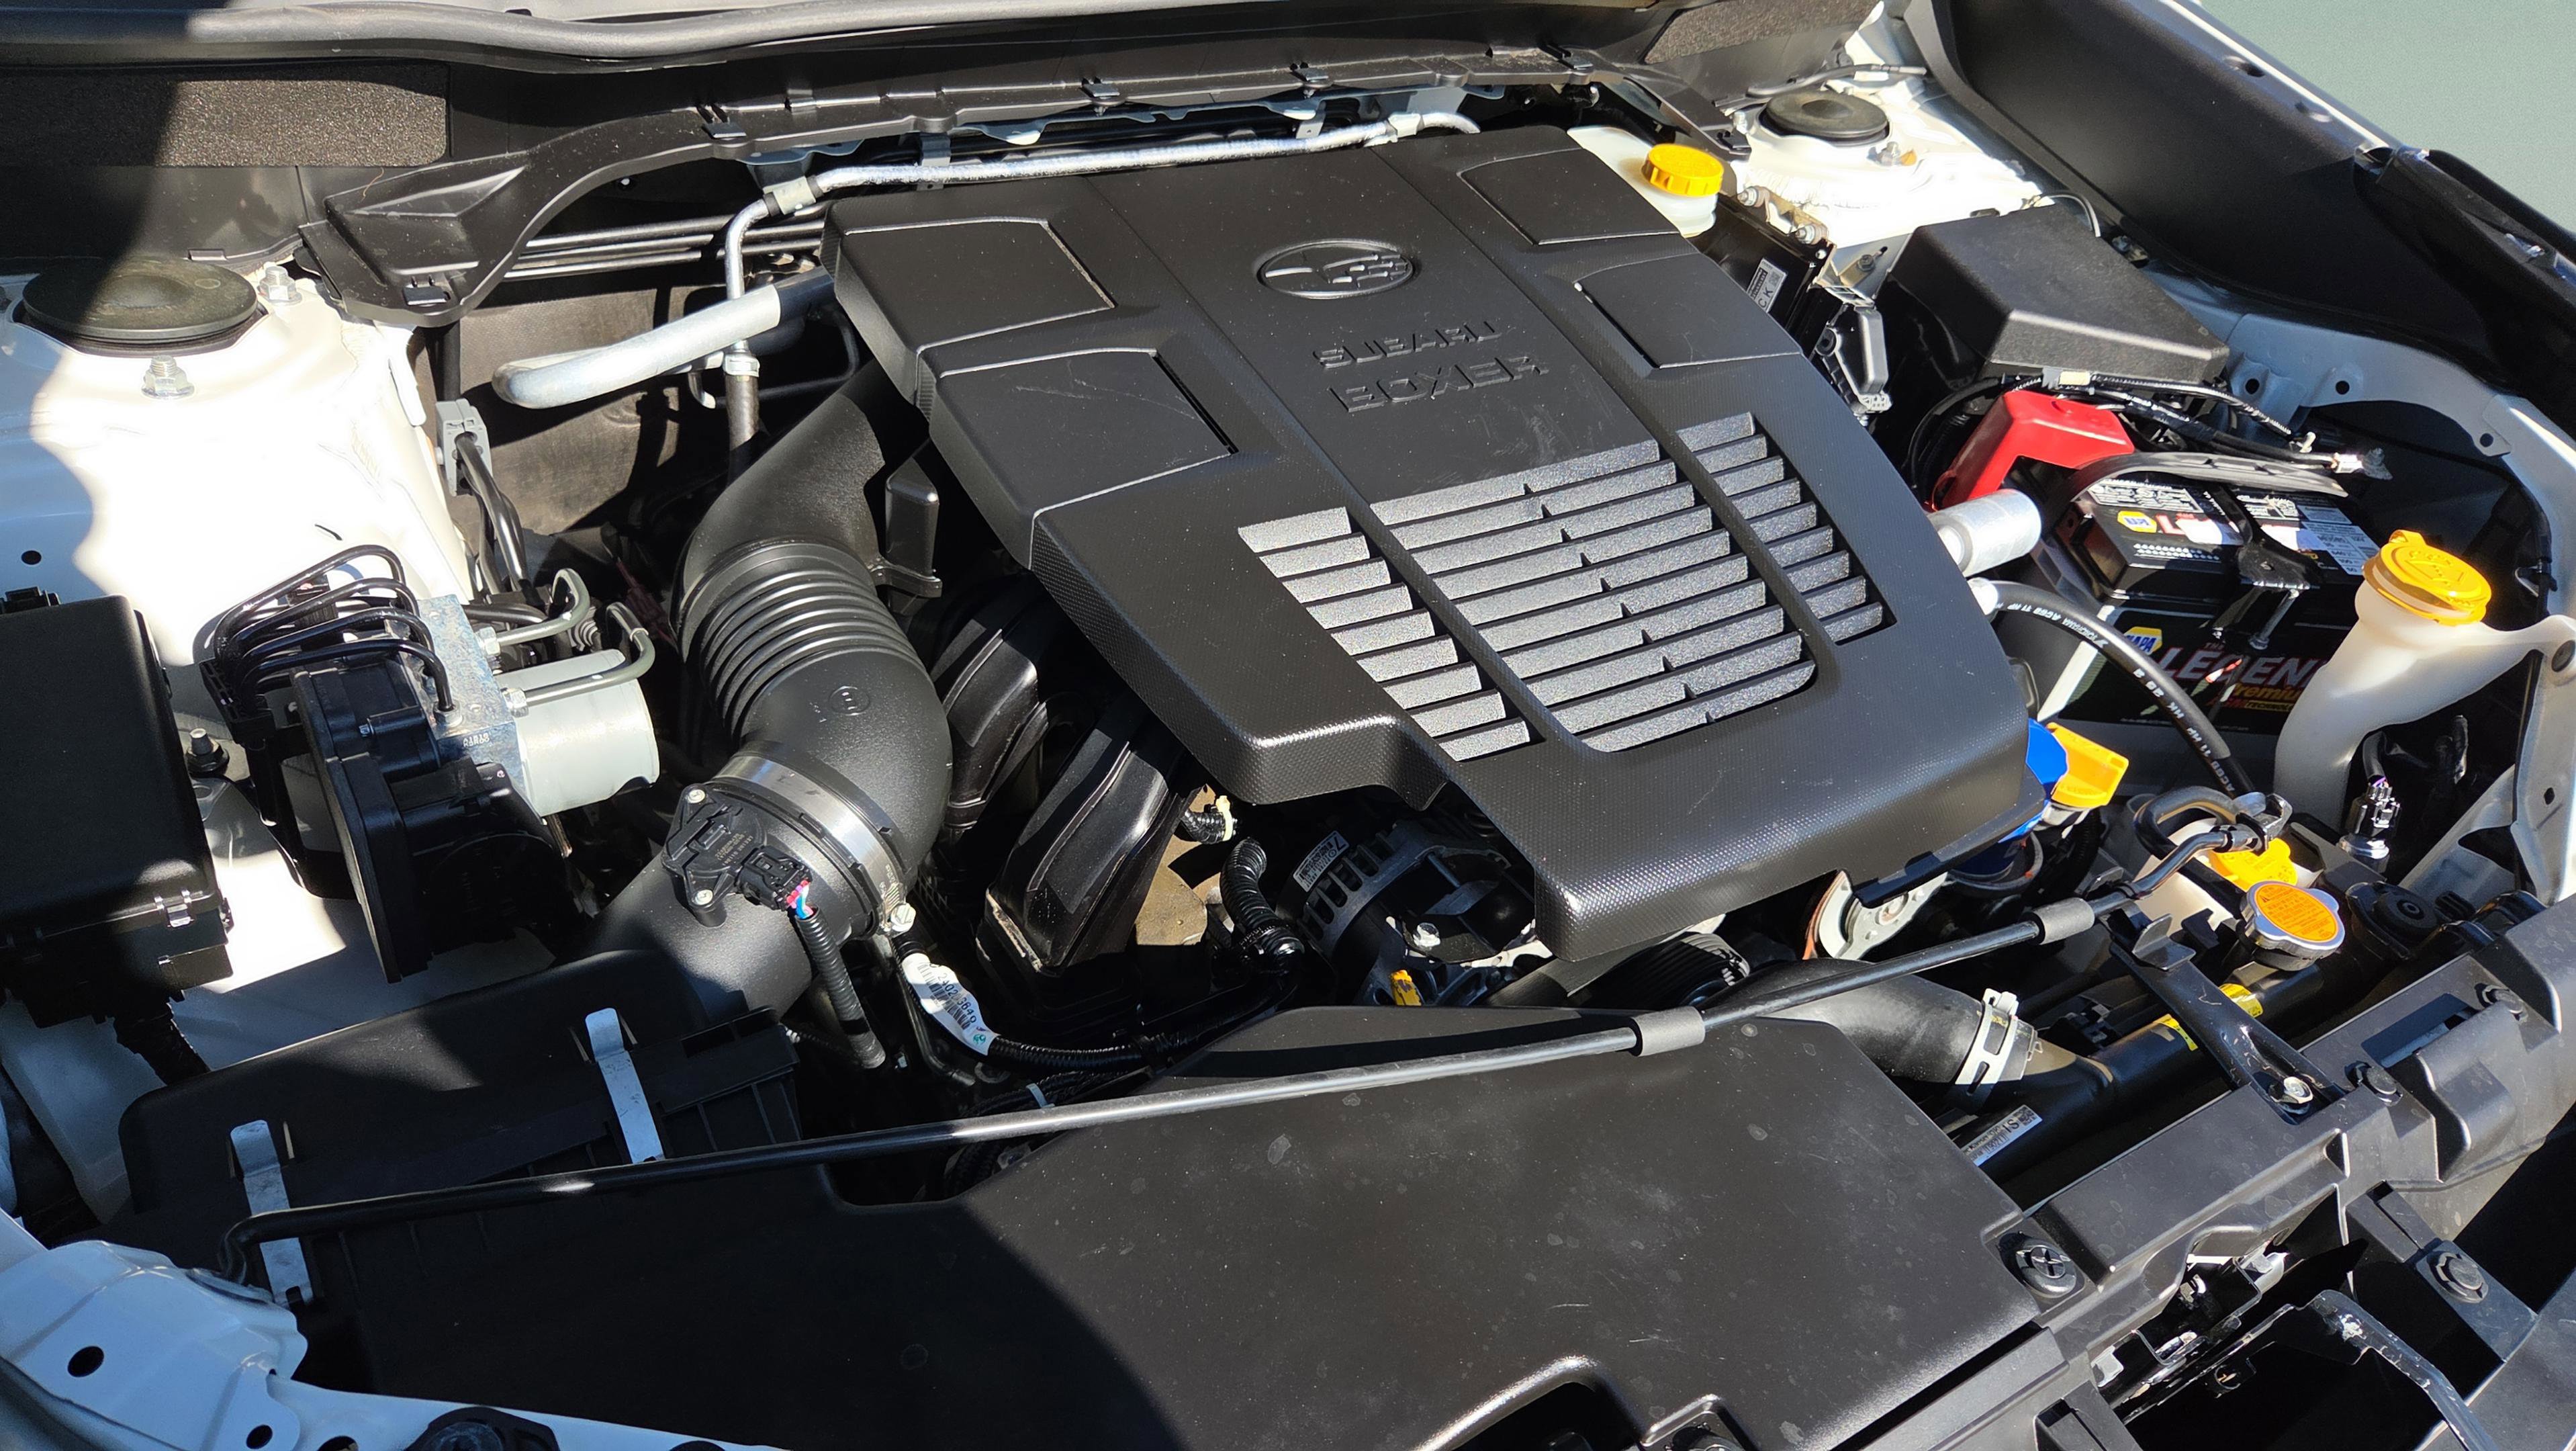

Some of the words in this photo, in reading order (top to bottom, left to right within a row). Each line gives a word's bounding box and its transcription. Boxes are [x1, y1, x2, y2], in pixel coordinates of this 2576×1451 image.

[1312, 320, 1504, 368] SUBARU
[1328, 355, 1549, 412] BOXER
[2158, 646, 2316, 688] LEGEN
[2235, 682, 2301, 700] Premiu
